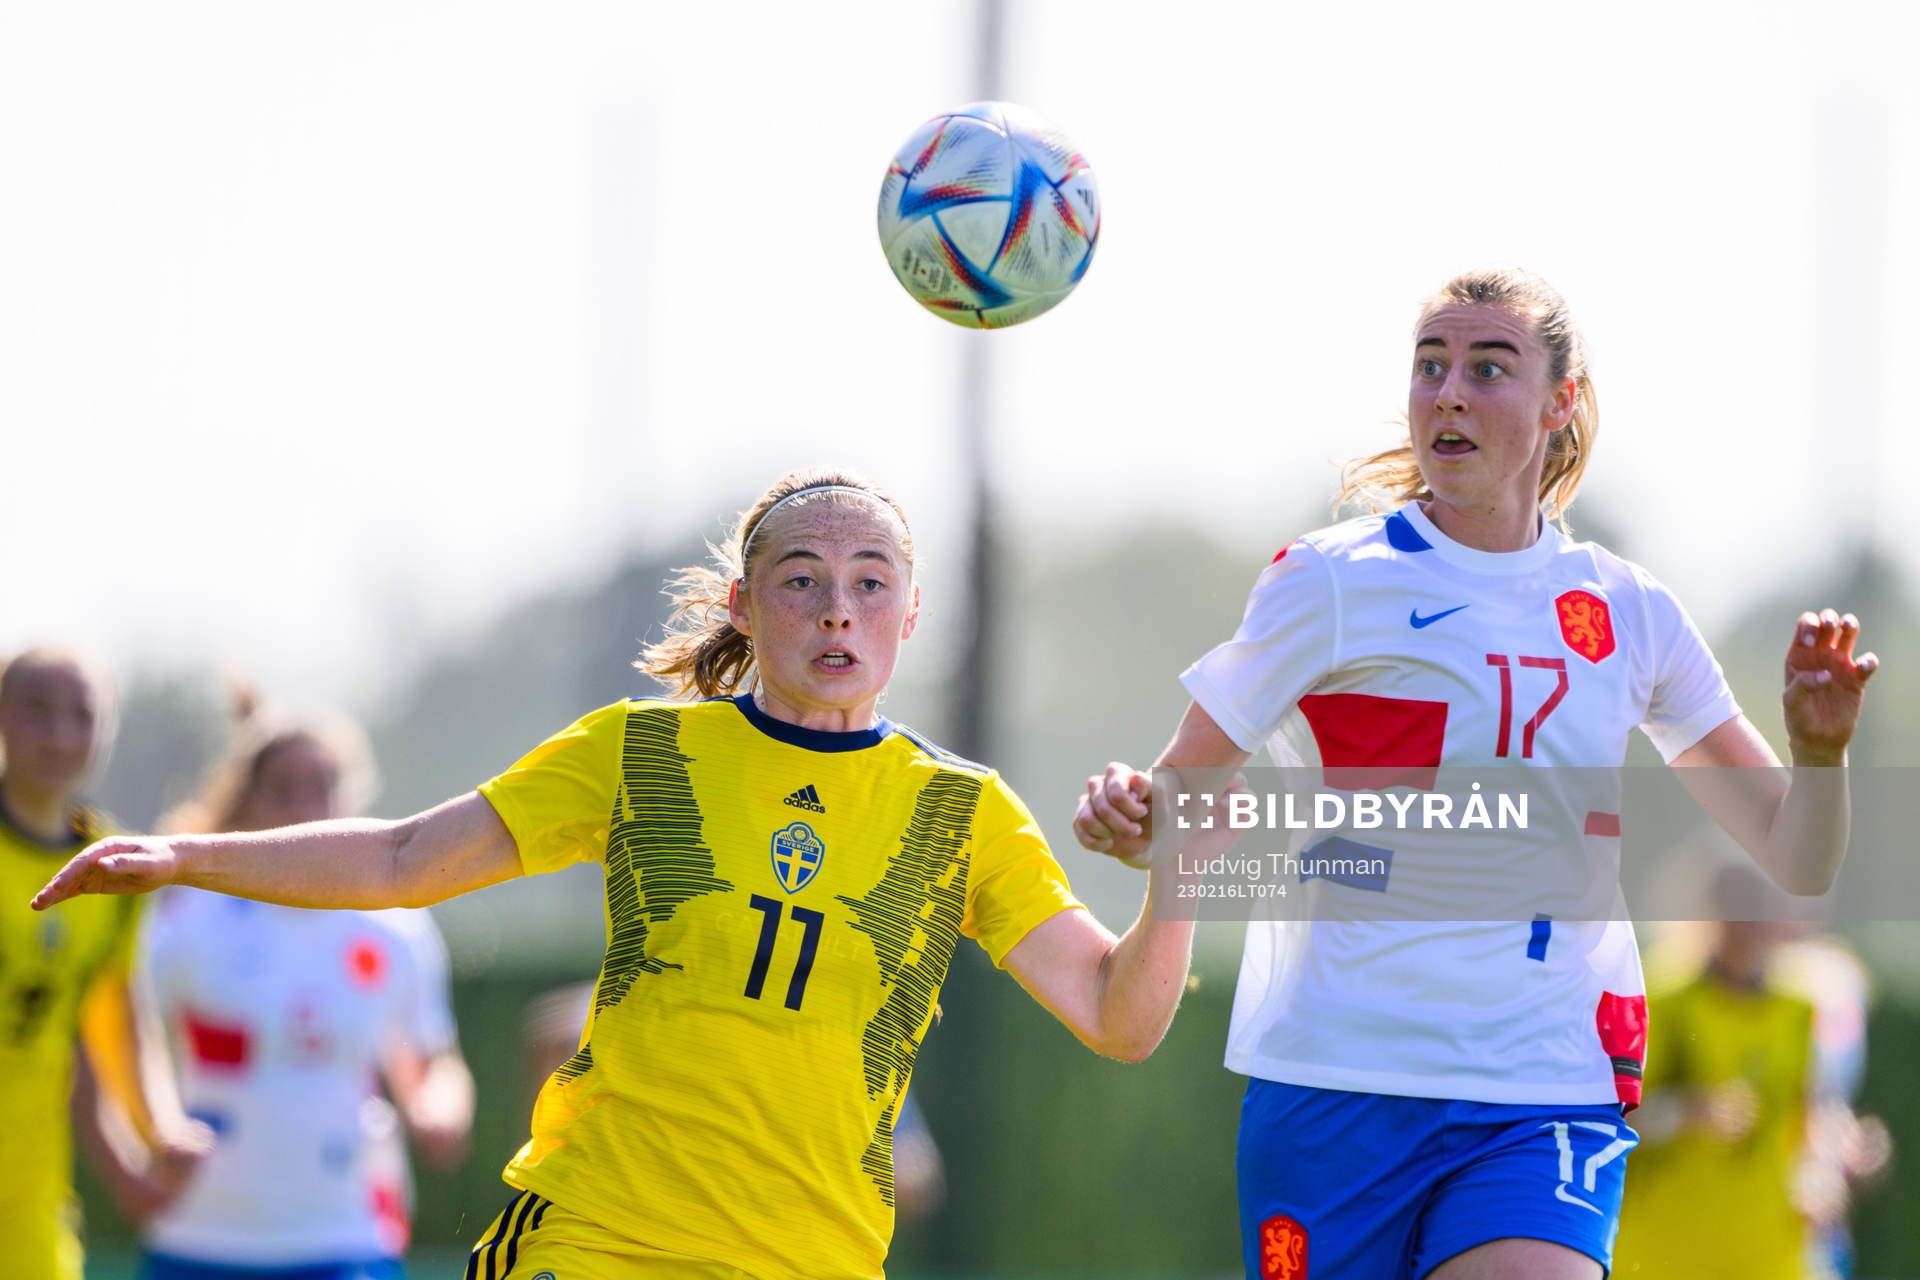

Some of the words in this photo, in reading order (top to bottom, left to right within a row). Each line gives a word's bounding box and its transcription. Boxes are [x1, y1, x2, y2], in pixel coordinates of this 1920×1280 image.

[1485, 653, 1569, 759] 17
[783, 796, 826, 814] adidas
[781, 840, 815, 853] SVERIGE
[744, 893, 825, 1012] 11
[1538, 1121, 1640, 1193] 17
